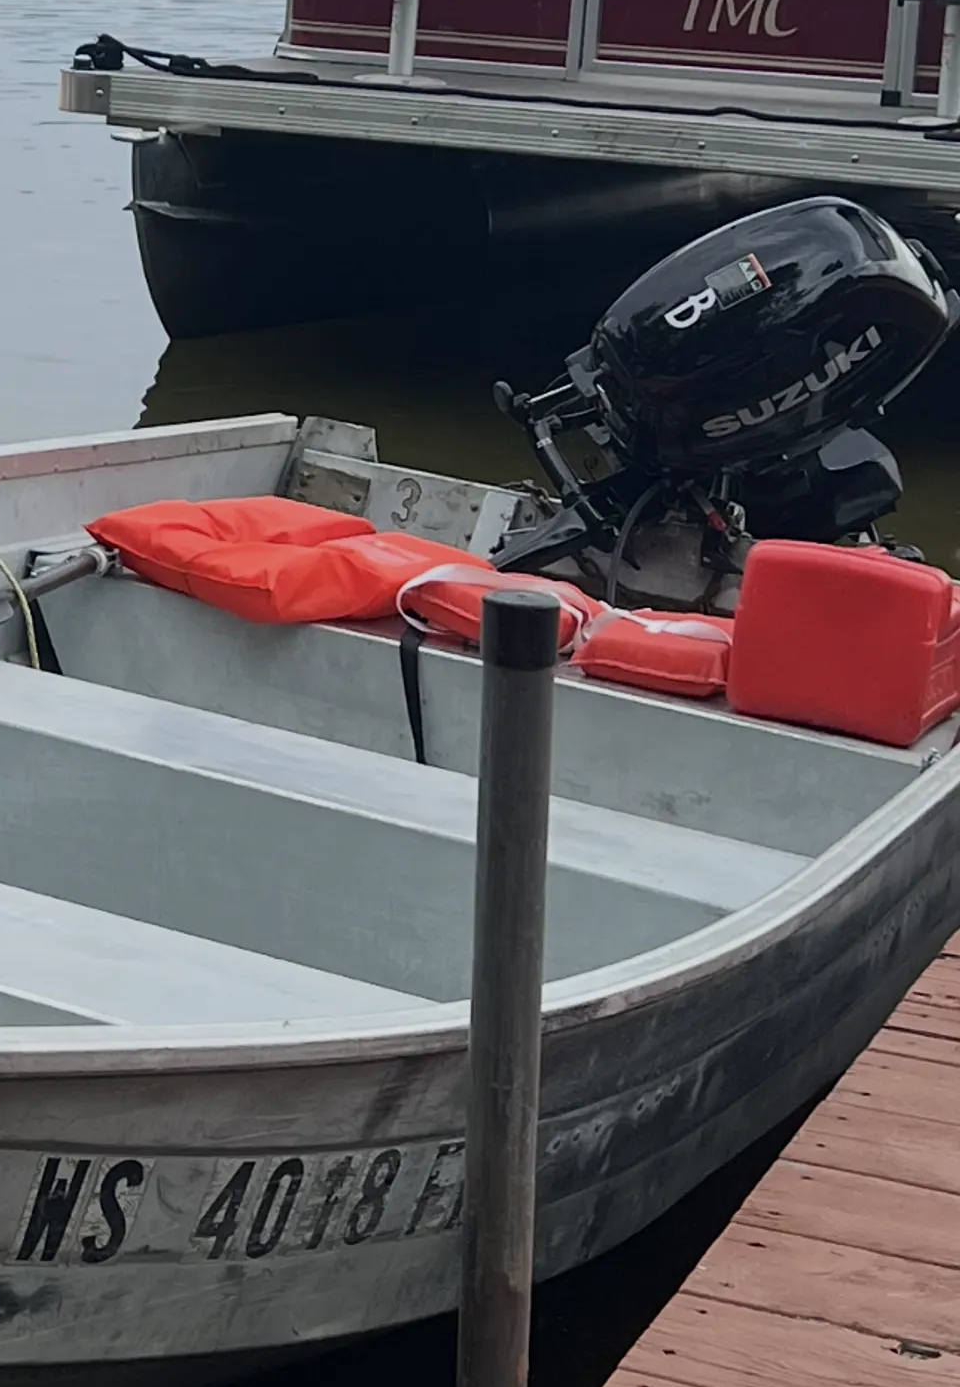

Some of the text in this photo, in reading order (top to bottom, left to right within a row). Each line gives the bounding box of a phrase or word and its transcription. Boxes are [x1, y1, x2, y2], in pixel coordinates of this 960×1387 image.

[701, 325, 883, 438] SUZUKI
[390, 477, 423, 530] 3
[15, 1156, 145, 1263] WS
